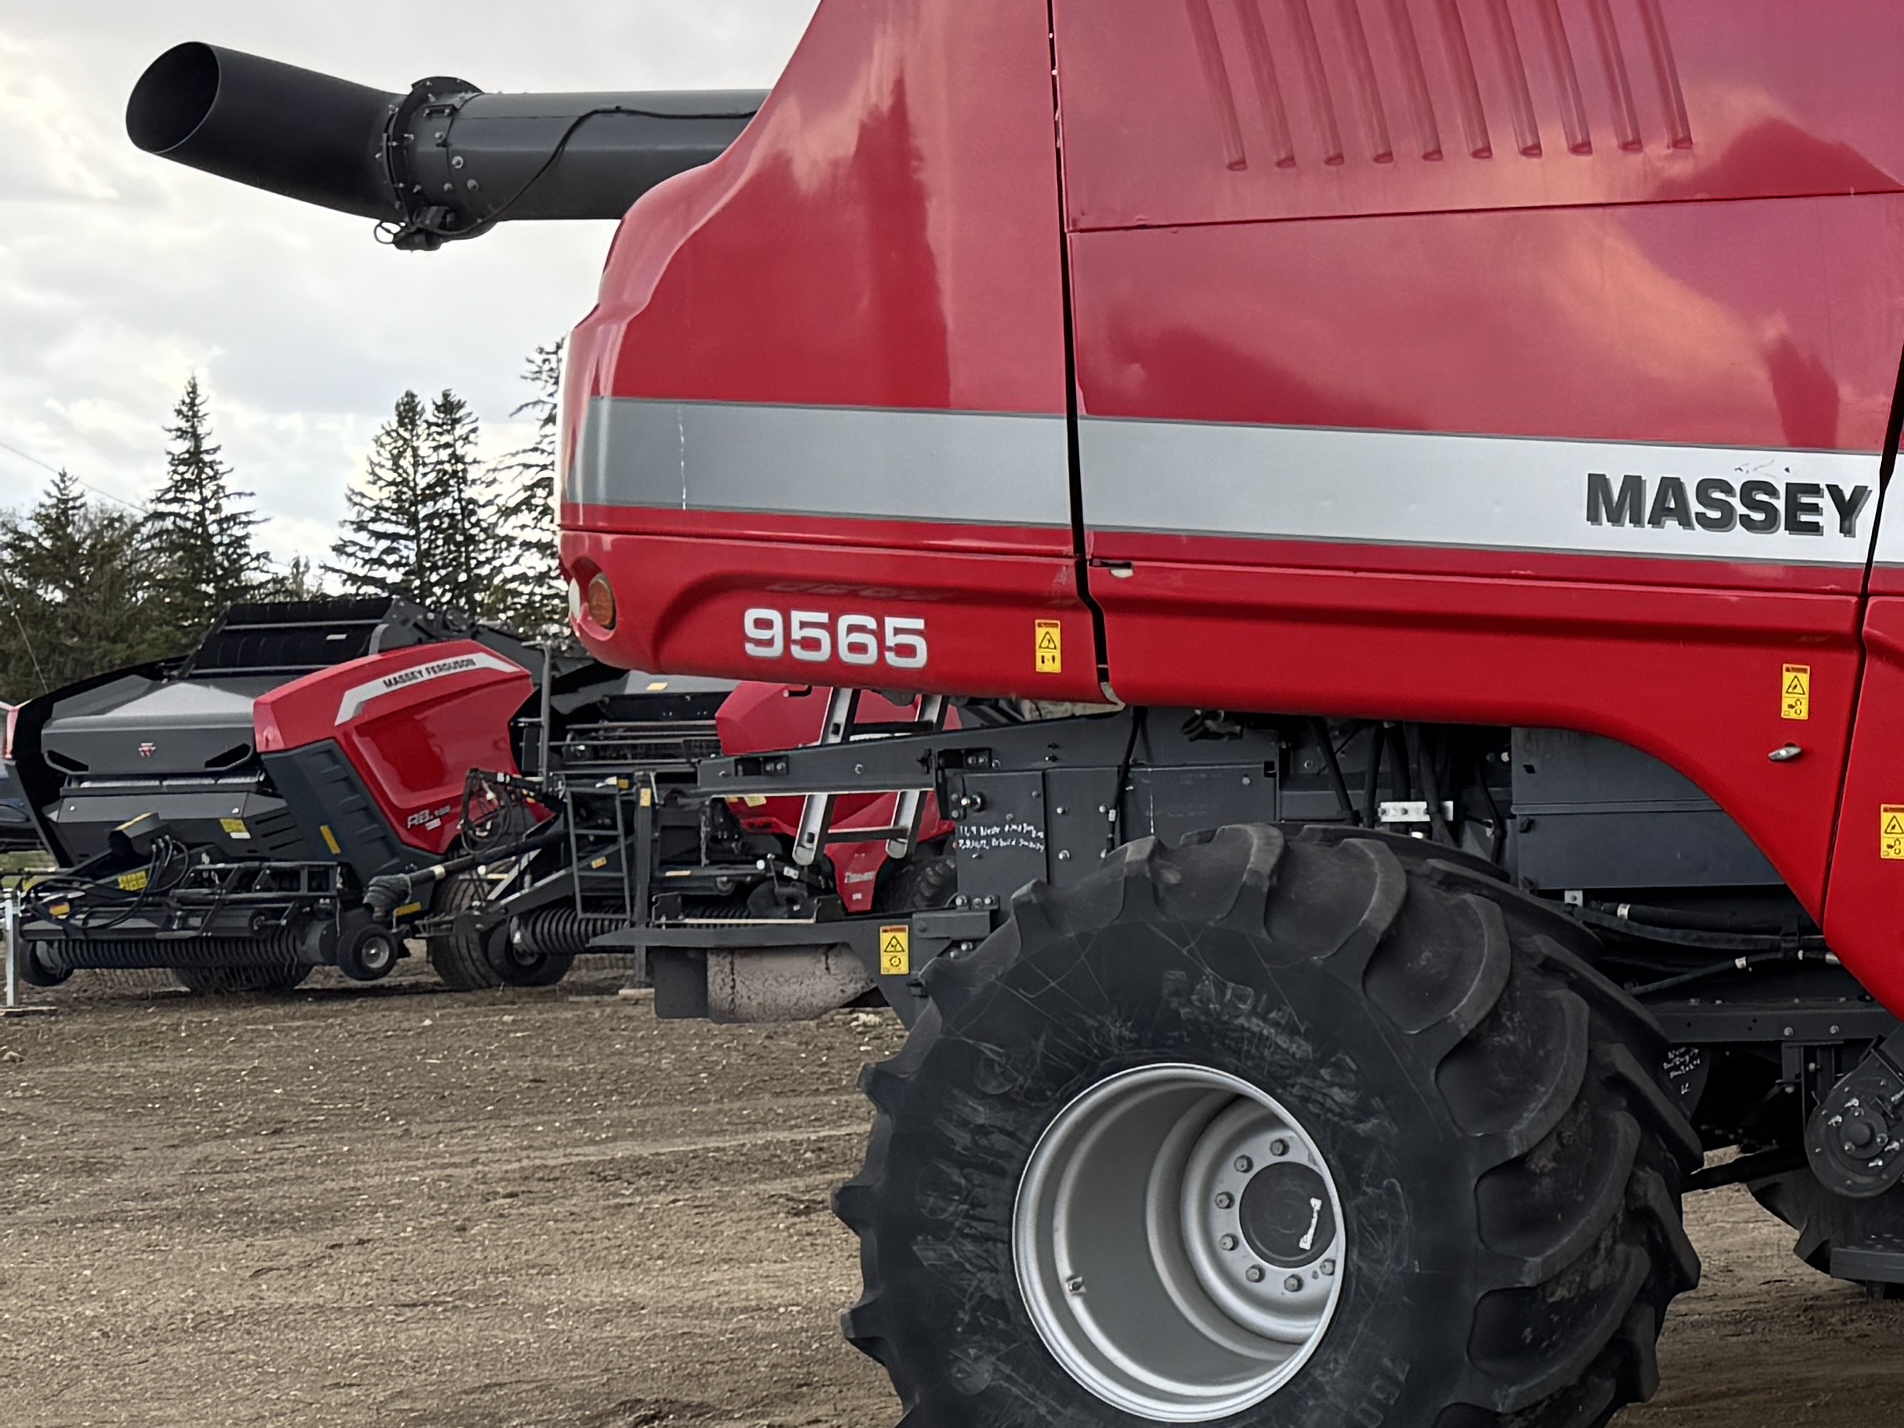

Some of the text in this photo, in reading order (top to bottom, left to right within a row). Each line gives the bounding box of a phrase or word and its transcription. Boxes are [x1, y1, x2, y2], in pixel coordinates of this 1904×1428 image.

[1586, 472, 1871, 539] MASSEY
[744, 608, 928, 669] 9565
[383, 658, 476, 688] MASSEY FERGUSON
